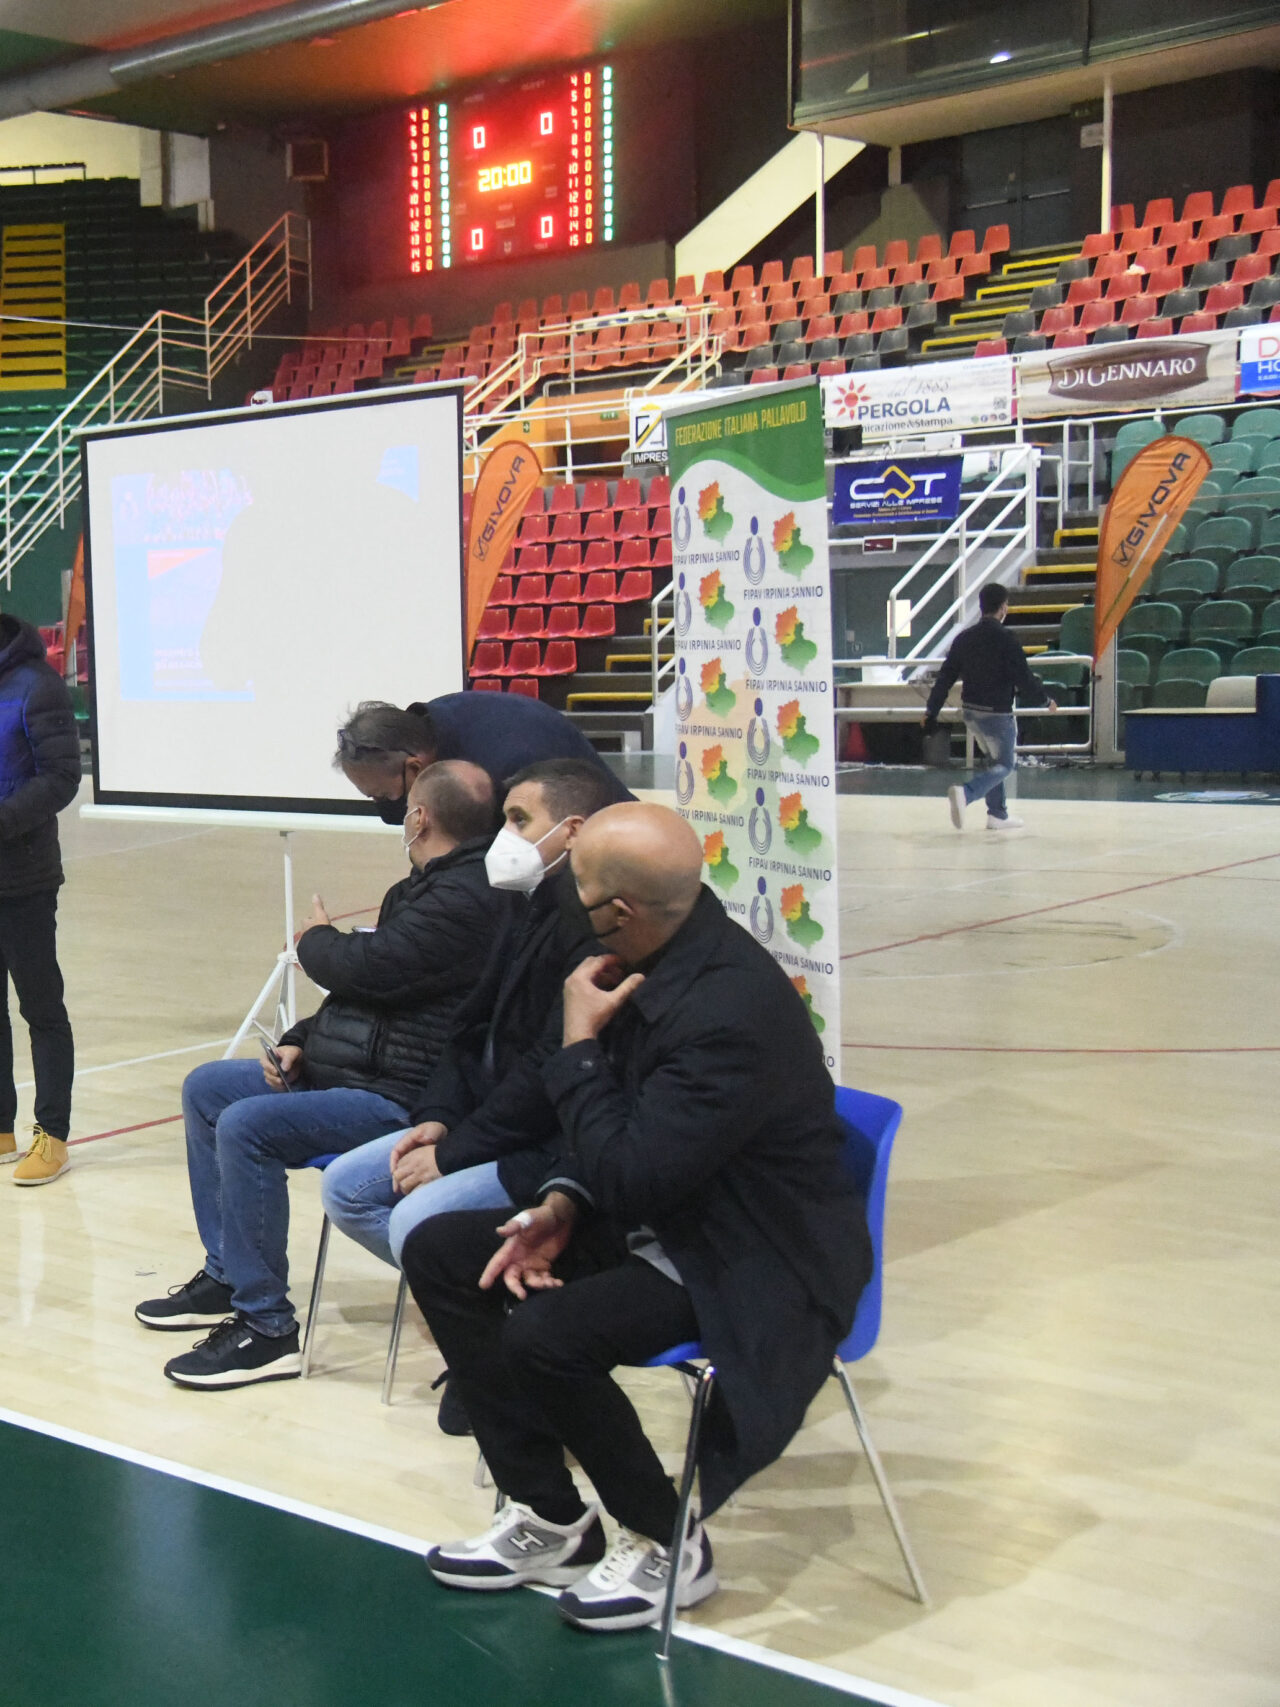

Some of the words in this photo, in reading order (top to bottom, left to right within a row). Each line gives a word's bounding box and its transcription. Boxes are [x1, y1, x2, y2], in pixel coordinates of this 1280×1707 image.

[571, 90, 577, 102] 5
[540, 112, 552, 135] 0
[473, 126, 485, 149] 0
[478, 160, 532, 192] 20:00
[569, 162, 578, 174] 10
[569, 191, 578, 203] 12
[569, 205, 578, 217] 13
[541, 216, 553, 238] 0
[570, 220, 578, 231] 14
[472, 228, 483, 250] 0
[570, 234, 578, 246] 15
[412, 261, 420, 272] 15
[1087, 357, 1196, 386] GENNARO
[858, 396, 952, 420] PERGOLA
[675, 422, 722, 446] FEDERAZIONE
[724, 414, 758, 436] ITALIANA
[762, 400, 807, 429] PALLAVOLO
[482, 454, 525, 544] GIVOVA
[1126, 452, 1192, 547] GIVOVA
[689, 554, 714, 564] IRPINIA
[716, 550, 740, 562] SANNIO
[744, 589, 762, 600] FIPAV
[764, 588, 790, 599] IRPINIA
[792, 586, 823, 598] SANNIO
[689, 640, 716, 650] IRPINIA
[717, 640, 741, 650] SANNIO
[746, 680, 764, 690] FIPAV
[766, 680, 792, 691] IRPINIA
[794, 680, 828, 693] SANNIO
[690, 725, 716, 736] IRPINIA
[718, 727, 742, 739] SANNIO
[748, 768, 766, 780] FIPAV
[768, 770, 794, 782] IRPINIA
[796, 774, 830, 787] SANNIO
[692, 810, 718, 822] IRPINIA
[719, 813, 744, 827] SANNIO
[748, 856, 768, 870] FIPAV
[770, 859, 796, 875] IRPINIA
[798, 865, 832, 882] SANNIO
[800, 954, 834, 974] SANNIO
